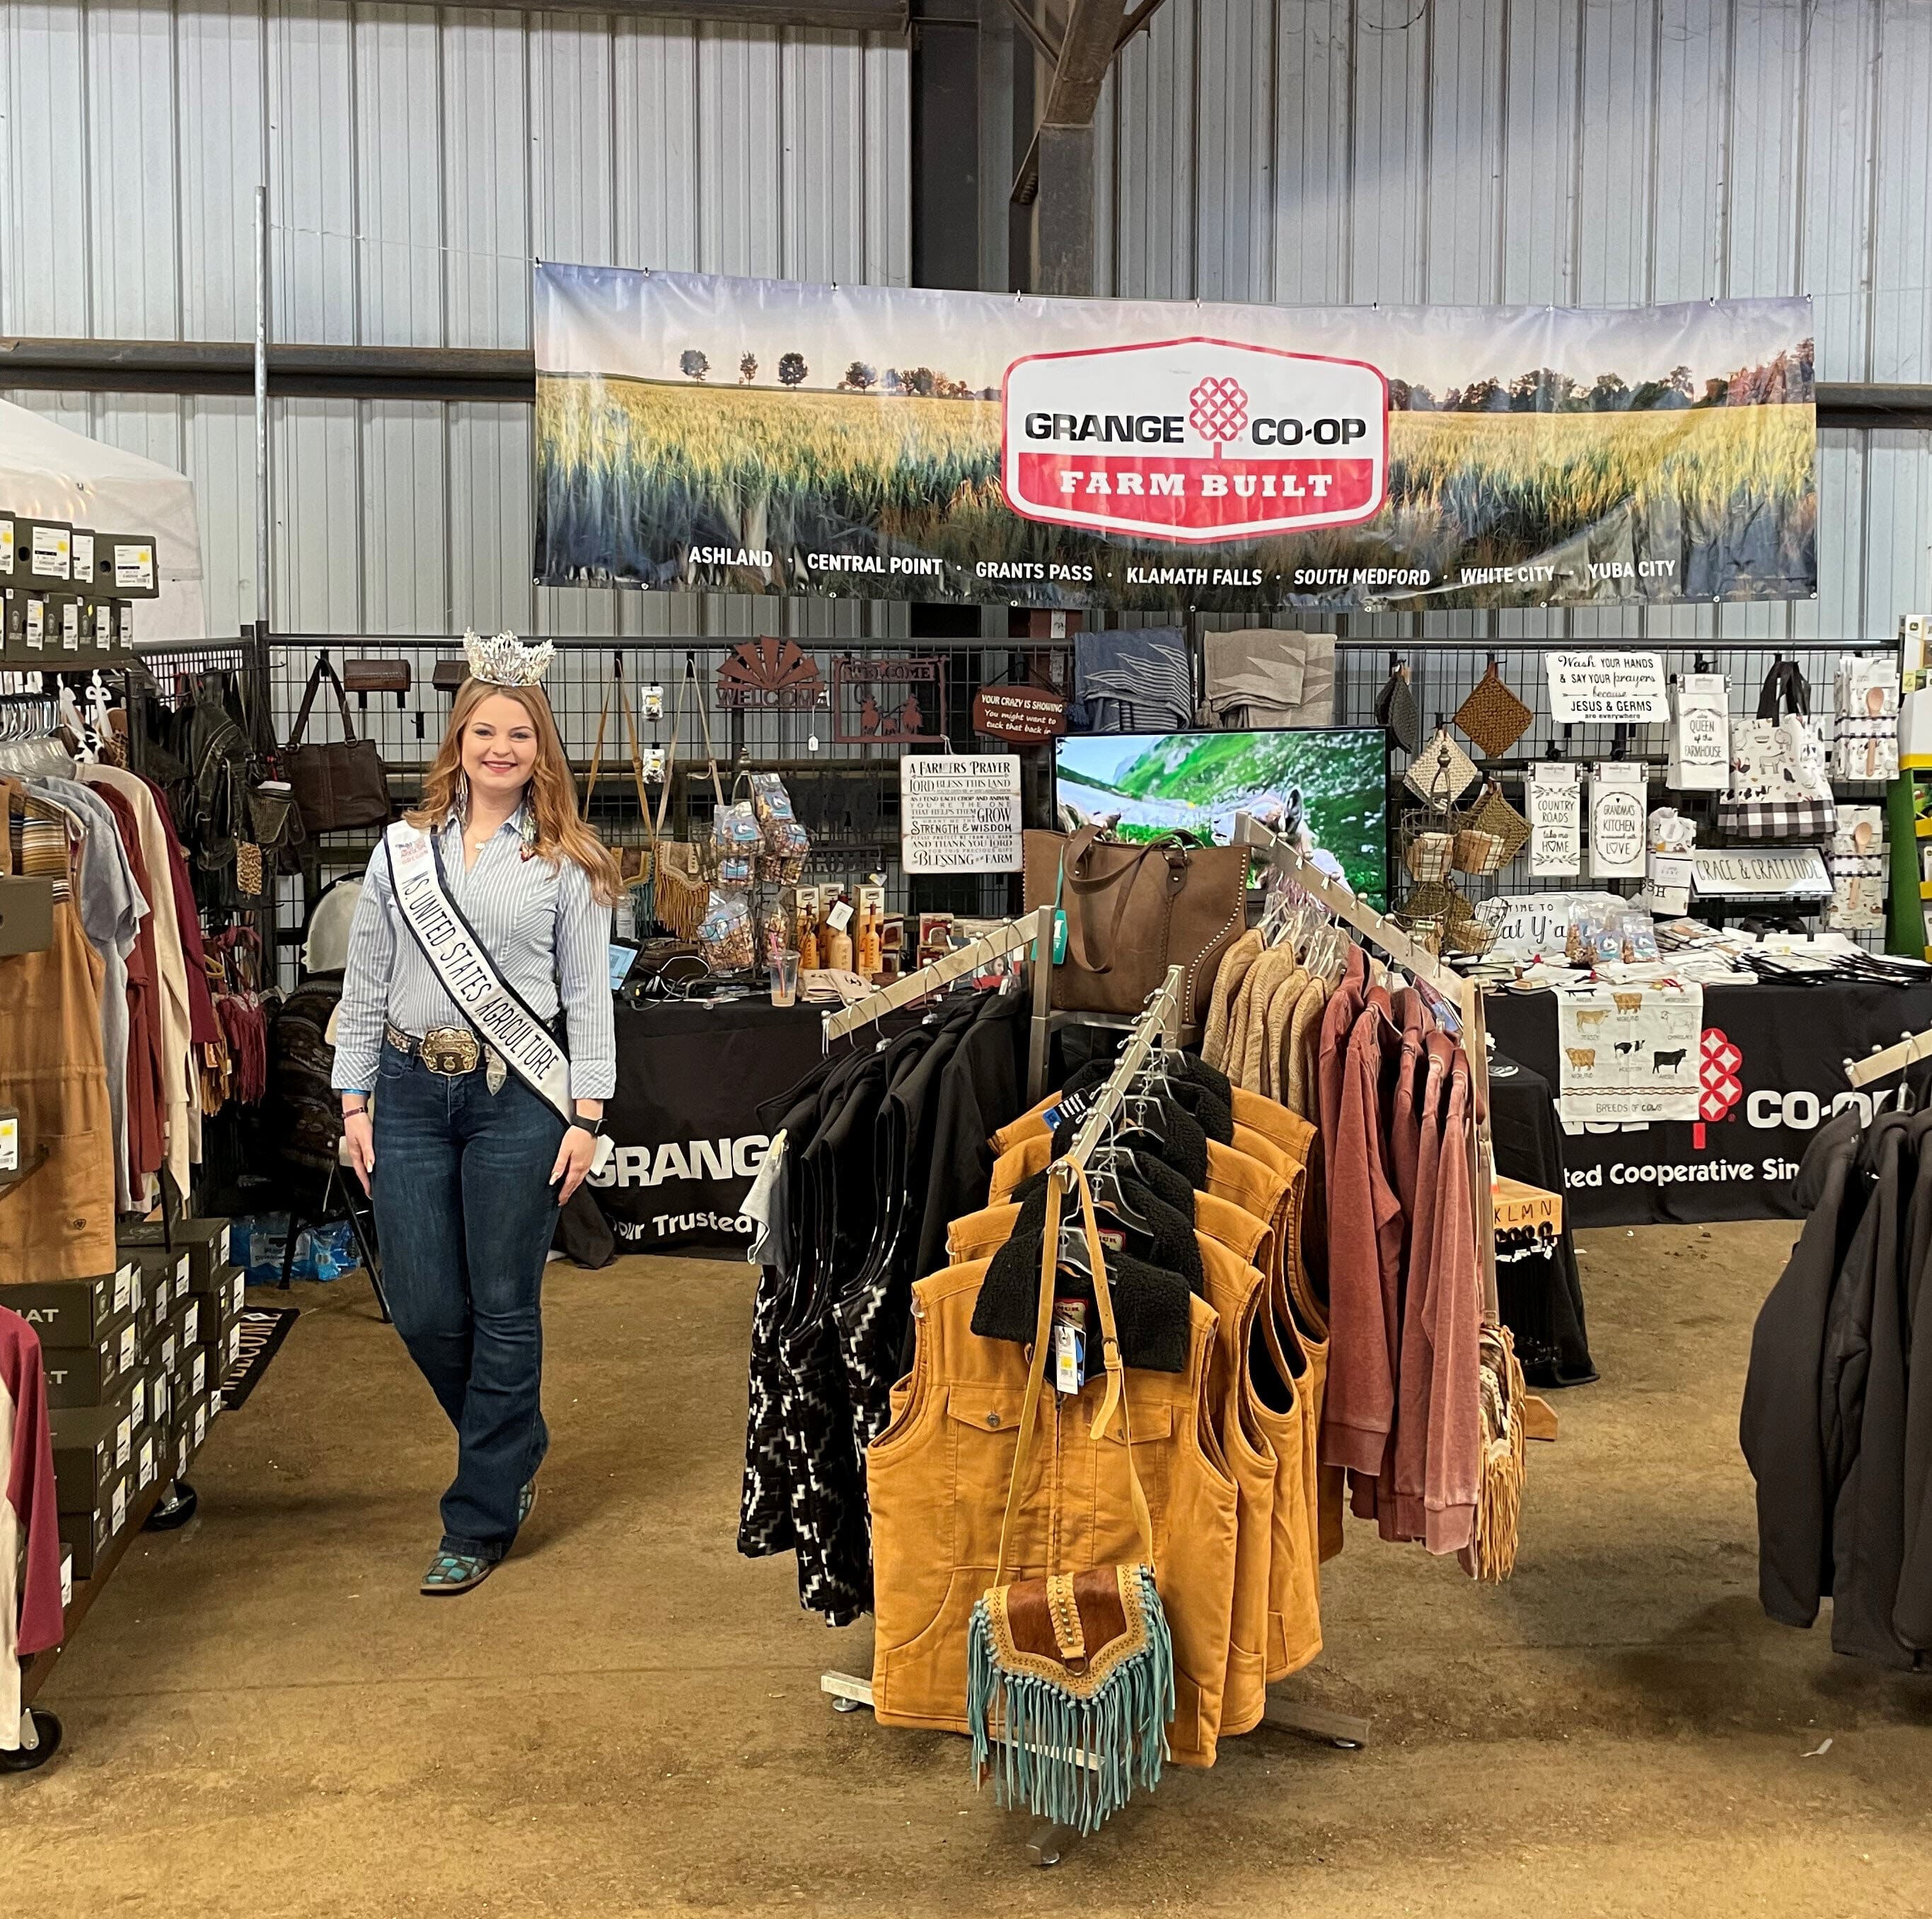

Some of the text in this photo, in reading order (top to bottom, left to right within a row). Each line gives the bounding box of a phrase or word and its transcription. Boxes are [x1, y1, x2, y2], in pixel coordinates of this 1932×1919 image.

[1025, 412, 1365, 446] GRANGE CO-OP
[1060, 471, 1333, 498] FARM BUILT
[688, 545, 1676, 586] ASHLAND CENTRAL POINT GRANTS PASS KLAMATH FALLS SOUTH MEDFORD WHITE CITY YUBA CITY
[1558, 655, 1654, 668] Wash YOUR HANDS
[846, 666, 930, 679] WELCOME
[1560, 671, 1656, 688] & SAY YOUR prayers
[716, 688, 825, 707] WELCOM
[1592, 685, 1627, 698] because
[981, 694, 1063, 713] YOUR CRAZY IS SHOWING
[1571, 701, 1652, 712] JESUS & GERMS
[984, 709, 998, 718] You
[1001, 712, 1024, 722] might
[1026, 715, 1046, 724] want
[1005, 722, 1023, 731] that
[1024, 724, 1042, 734] back
[1689, 720, 1715, 734] QUEEN
[1694, 734, 1701, 743] of
[1684, 745, 1721, 758] FARMHOUSE
[909, 763, 916, 774] A
[969, 761, 1010, 775] PRAYER
[910, 779, 935, 794] LORD
[936, 779, 963, 788] BLESS
[966, 779, 985, 788] THIS
[988, 779, 1011, 789] LAND
[1538, 800, 1575, 811] COUNTRY
[1603, 805, 1635, 816] GRANDMA'S
[977, 808, 1012, 823] GROW
[1542, 812, 1568, 823] ROADS
[910, 821, 1012, 835] STRENGTH & WISDOM
[1603, 819, 1635, 832] KITCHEN
[1543, 830, 1556, 839] take
[990, 840, 1012, 848] LORD
[913, 850, 974, 866] BLESSING
[985, 854, 1012, 864] FARM
[1696, 859, 1736, 881] GRACE
[1737, 859, 1750, 879] &
[1751, 858, 1823, 880] GRATITUDE
[1508, 903, 1554, 913] TIME TO
[409, 890, 456, 947] UNITED
[440, 942, 492, 1002] STATES
[475, 996, 560, 1081] AGRICULTURE
[1596, 1103, 1662, 1113] BREEDS OF COWS
[1747, 1090, 1895, 1130] CO-O
[1609, 1159, 1754, 1186] Cooperative
[1494, 1200, 1551, 1224] K L M N
[613, 1220, 645, 1240] our
